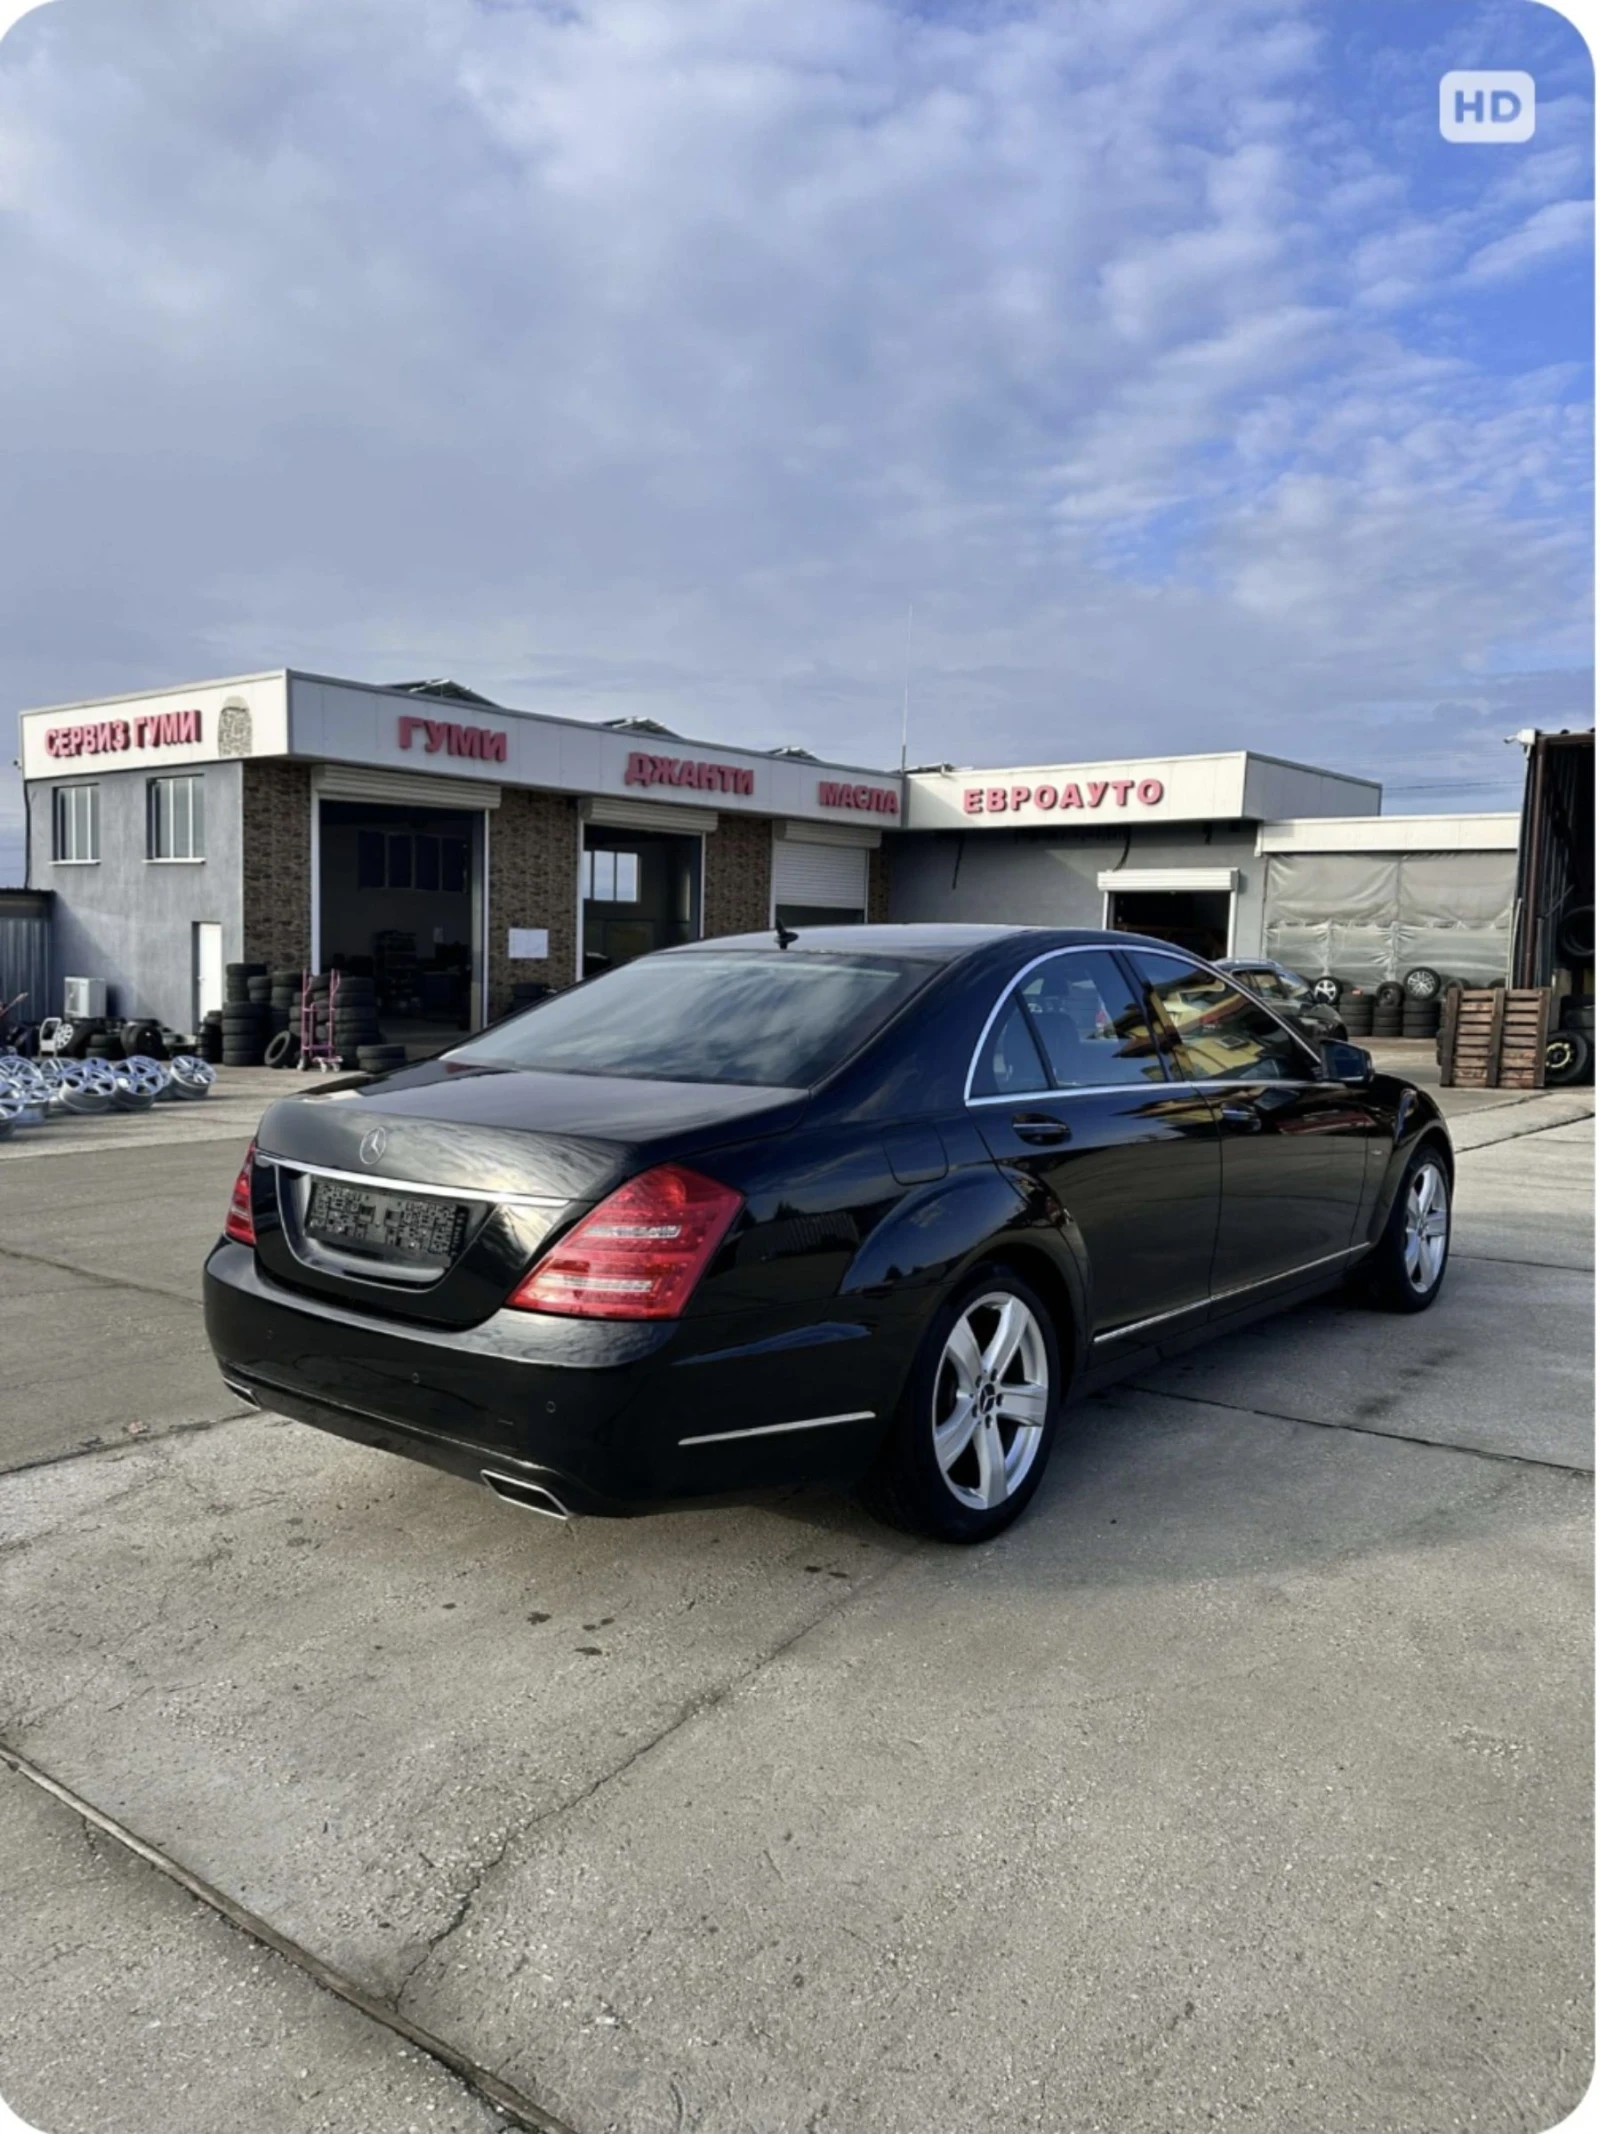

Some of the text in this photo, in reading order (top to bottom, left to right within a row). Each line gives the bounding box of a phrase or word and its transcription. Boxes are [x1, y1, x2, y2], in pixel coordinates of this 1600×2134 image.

[45, 709, 202, 757] СЕРВИЗ ГУМИ
[398, 716, 507, 762] ГУМИ
[625, 752, 753, 795] ДЖАНТИ
[818, 781, 899, 813] МАСЛА
[963, 778, 1164, 814] ЕВРОАУТО
